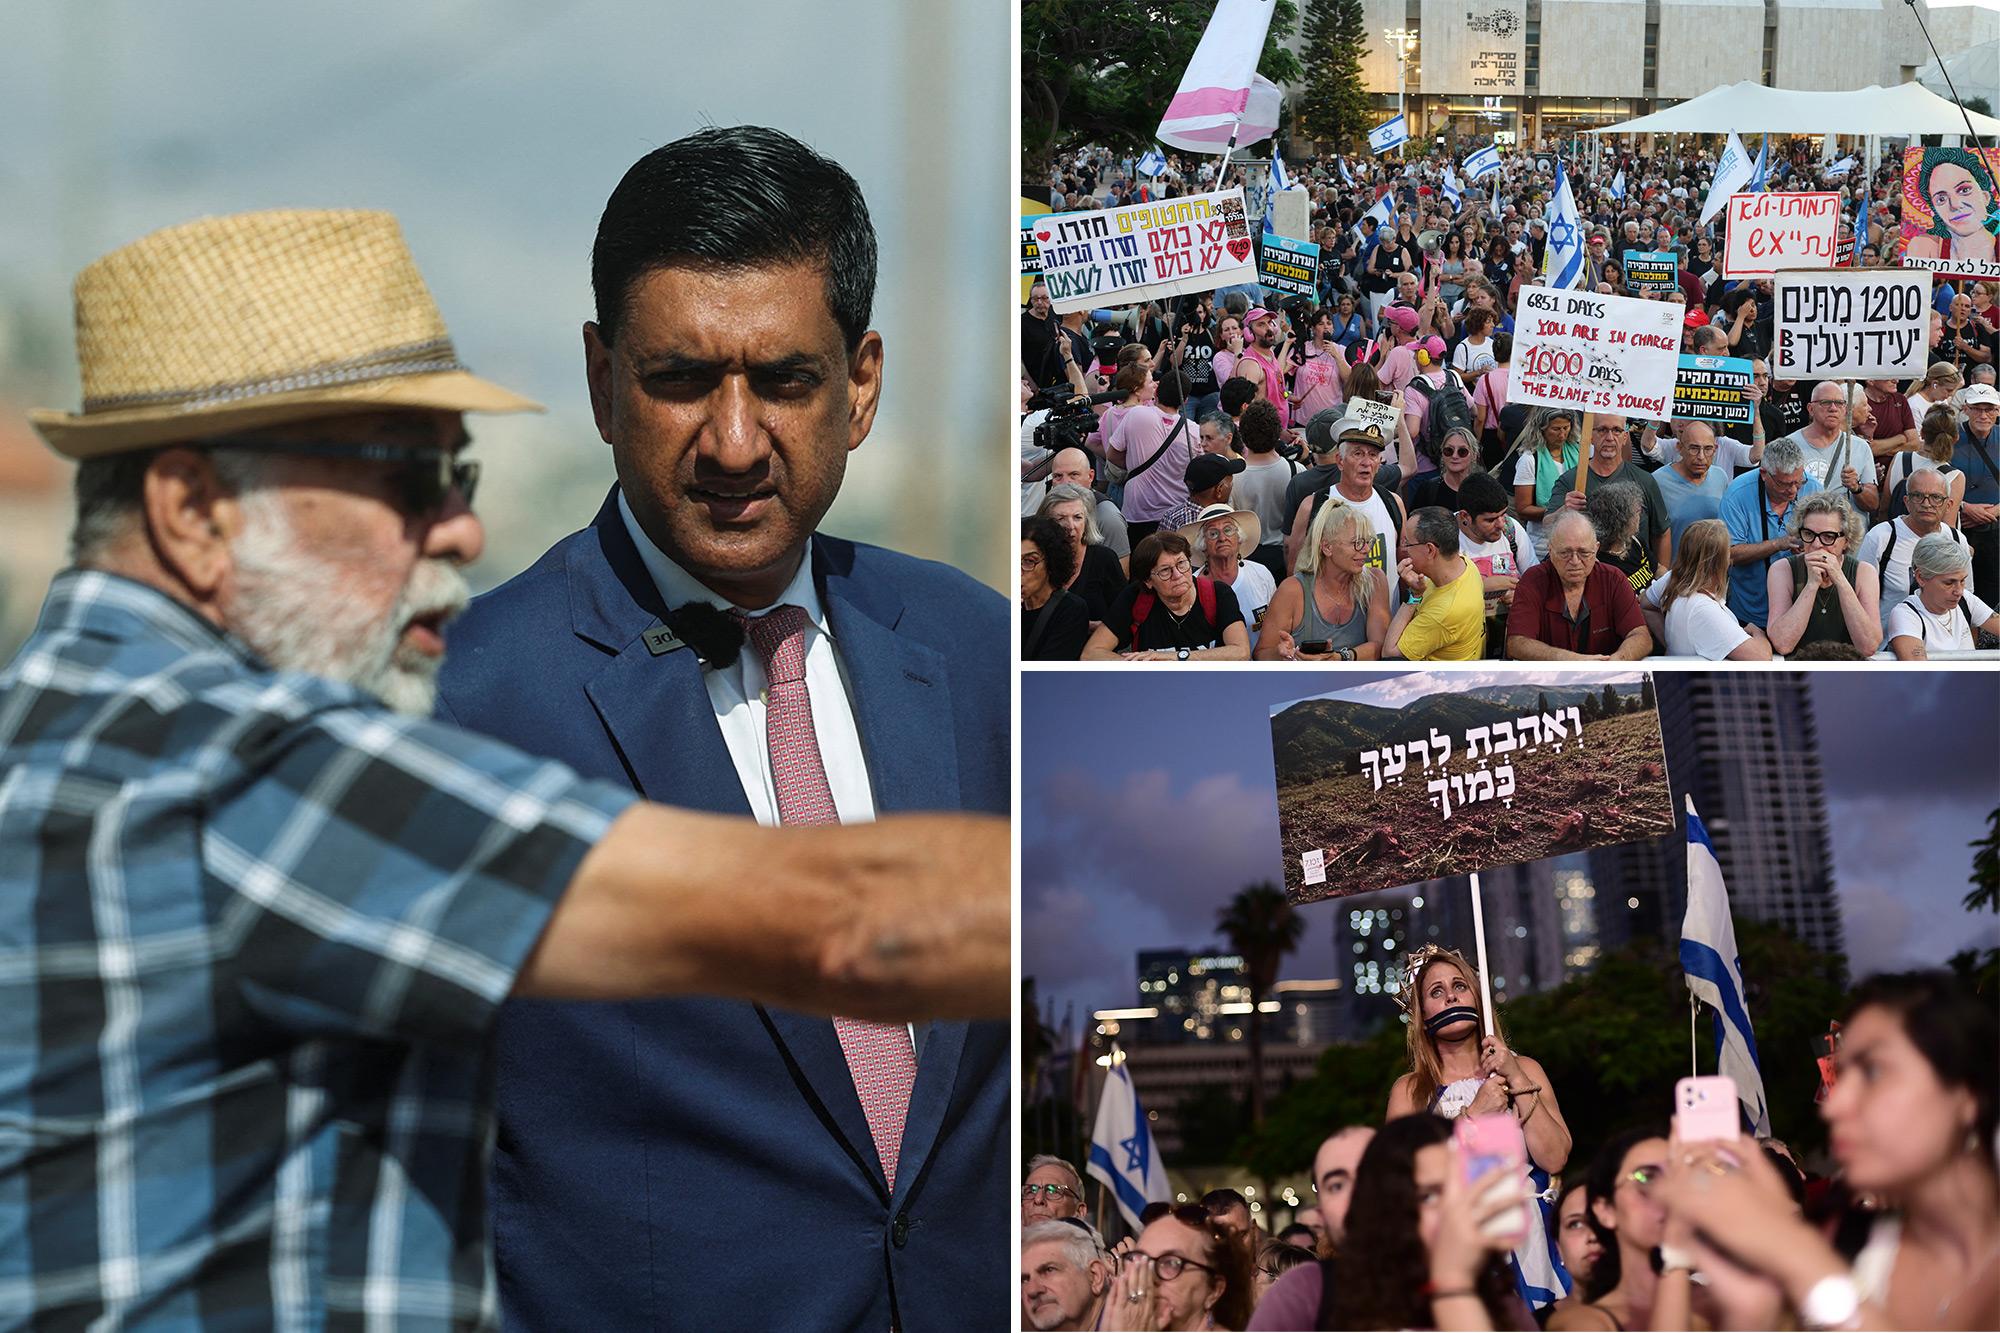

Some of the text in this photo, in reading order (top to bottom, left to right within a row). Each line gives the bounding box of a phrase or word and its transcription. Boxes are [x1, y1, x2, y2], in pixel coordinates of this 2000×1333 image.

[1116, 199, 1211, 234] החטופים
[1147, 226, 1192, 253] כולם
[1197, 219, 1226, 244] לא
[1099, 235, 1140, 260] חזרו
[1199, 243, 1224, 272] לא
[1264, 247, 1291, 262] חקירה
[1291, 252, 1315, 268] ועדת
[1109, 258, 1148, 288] יחזרו
[1154, 249, 1193, 279] כולם
[1266, 261, 1309, 281] ממלכתית
[1631, 271, 1669, 280] ממלכתית
[1955, 258, 1974, 273] לא
[1527, 293, 1606, 319] 6851 DAYS
[1860, 285, 1921, 323] 1200
[1536, 319, 1676, 351] YOU ARE IN CHARGE
[1523, 346, 1583, 377] 1000
[1796, 325, 1848, 373] עליך
[1678, 371, 1748, 386] ועדת חקיר
[1522, 381, 1666, 416] THE BLAME IS YOURS!
[1675, 386, 1741, 402] ממלכתית
[1693, 404, 1722, 416] ביטחון
[1724, 407, 1748, 419] למען
